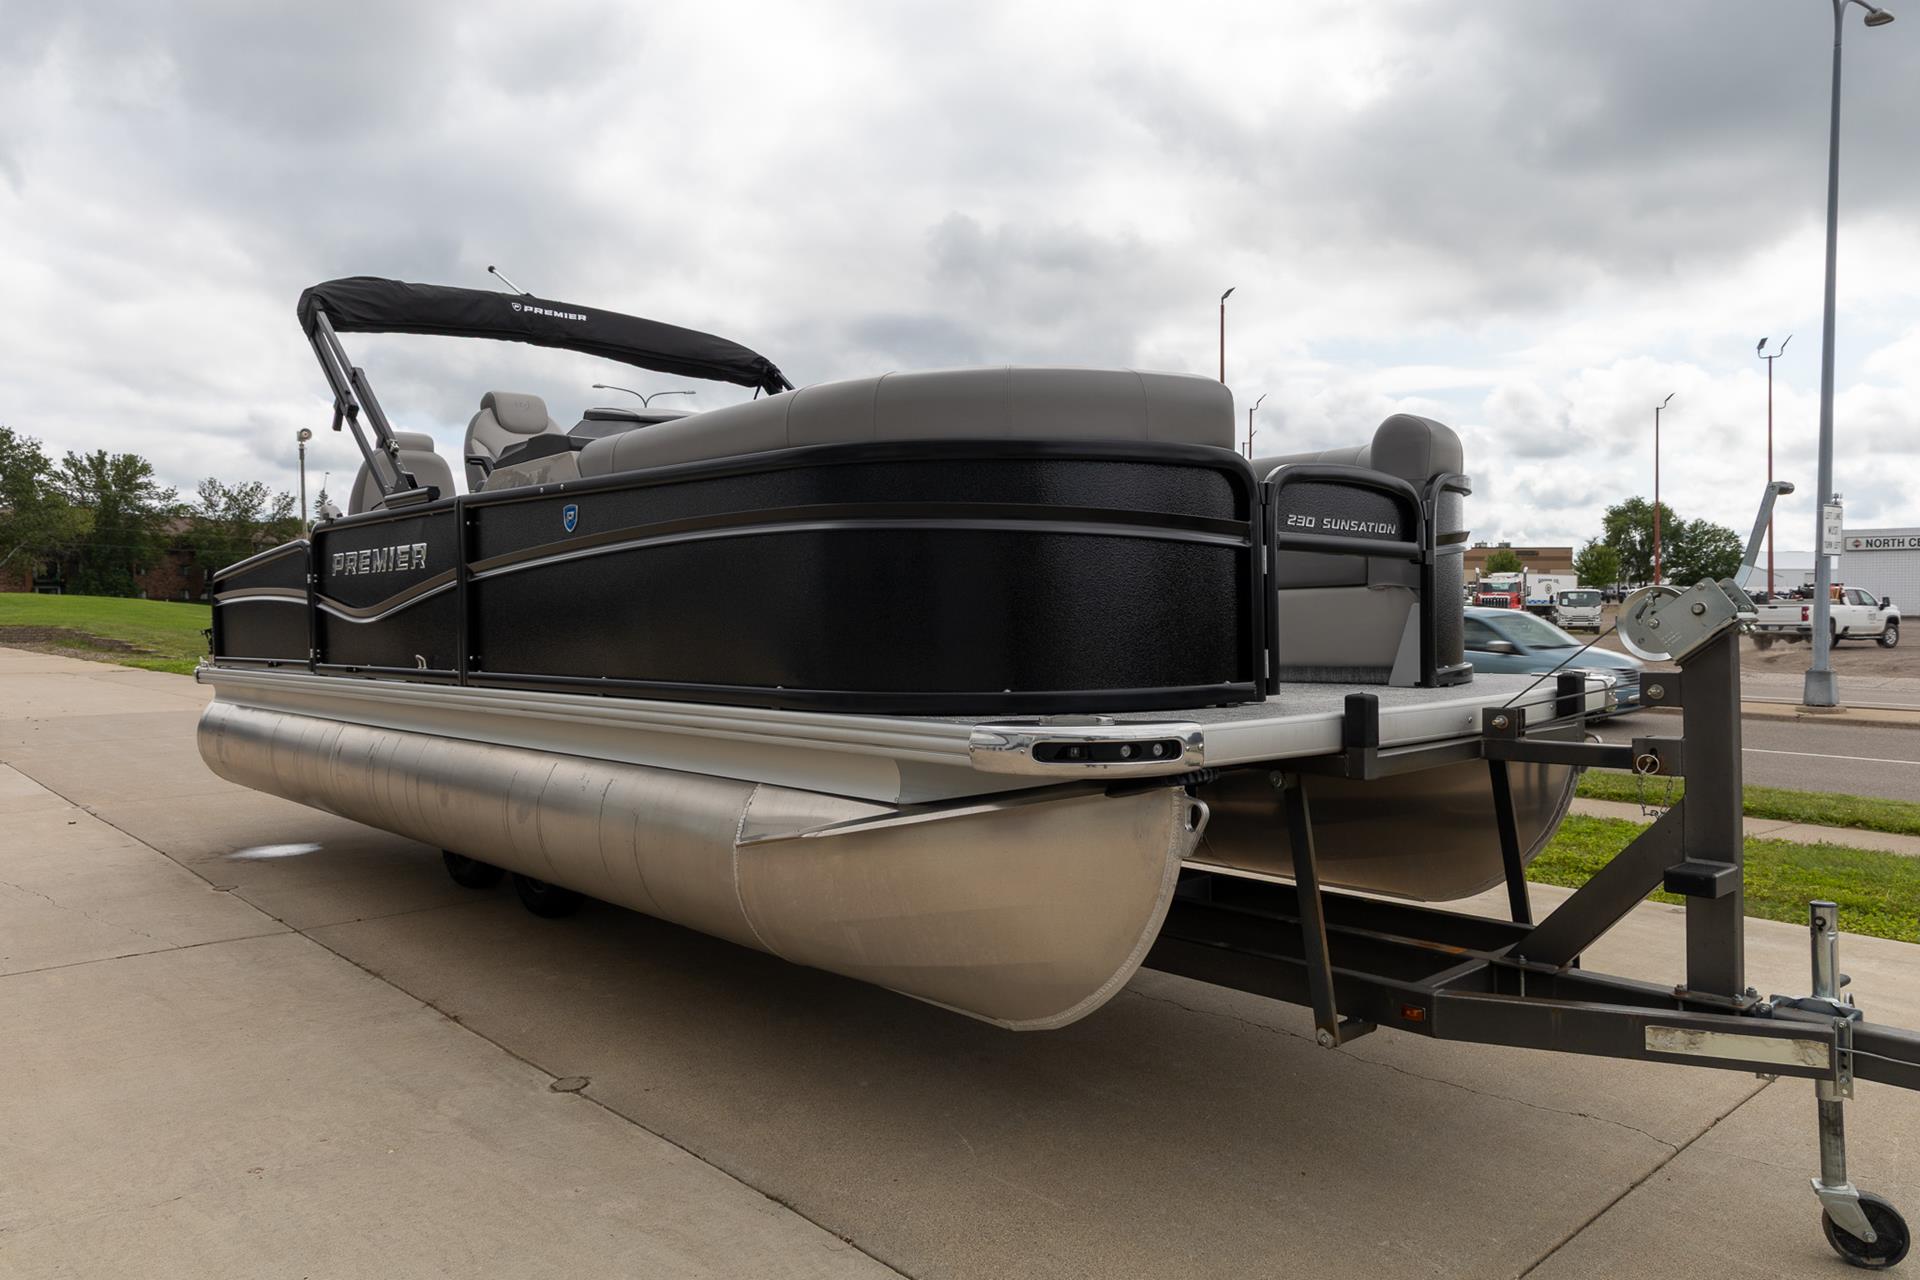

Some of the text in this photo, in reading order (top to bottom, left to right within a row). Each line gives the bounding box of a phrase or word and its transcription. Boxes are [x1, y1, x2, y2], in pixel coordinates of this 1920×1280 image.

[523, 304, 588, 322] PREMIER
[1287, 514, 1396, 535] 230 SUNSATION
[1865, 538, 1905, 548] NORTH
[332, 542, 428, 577] PREMIER
